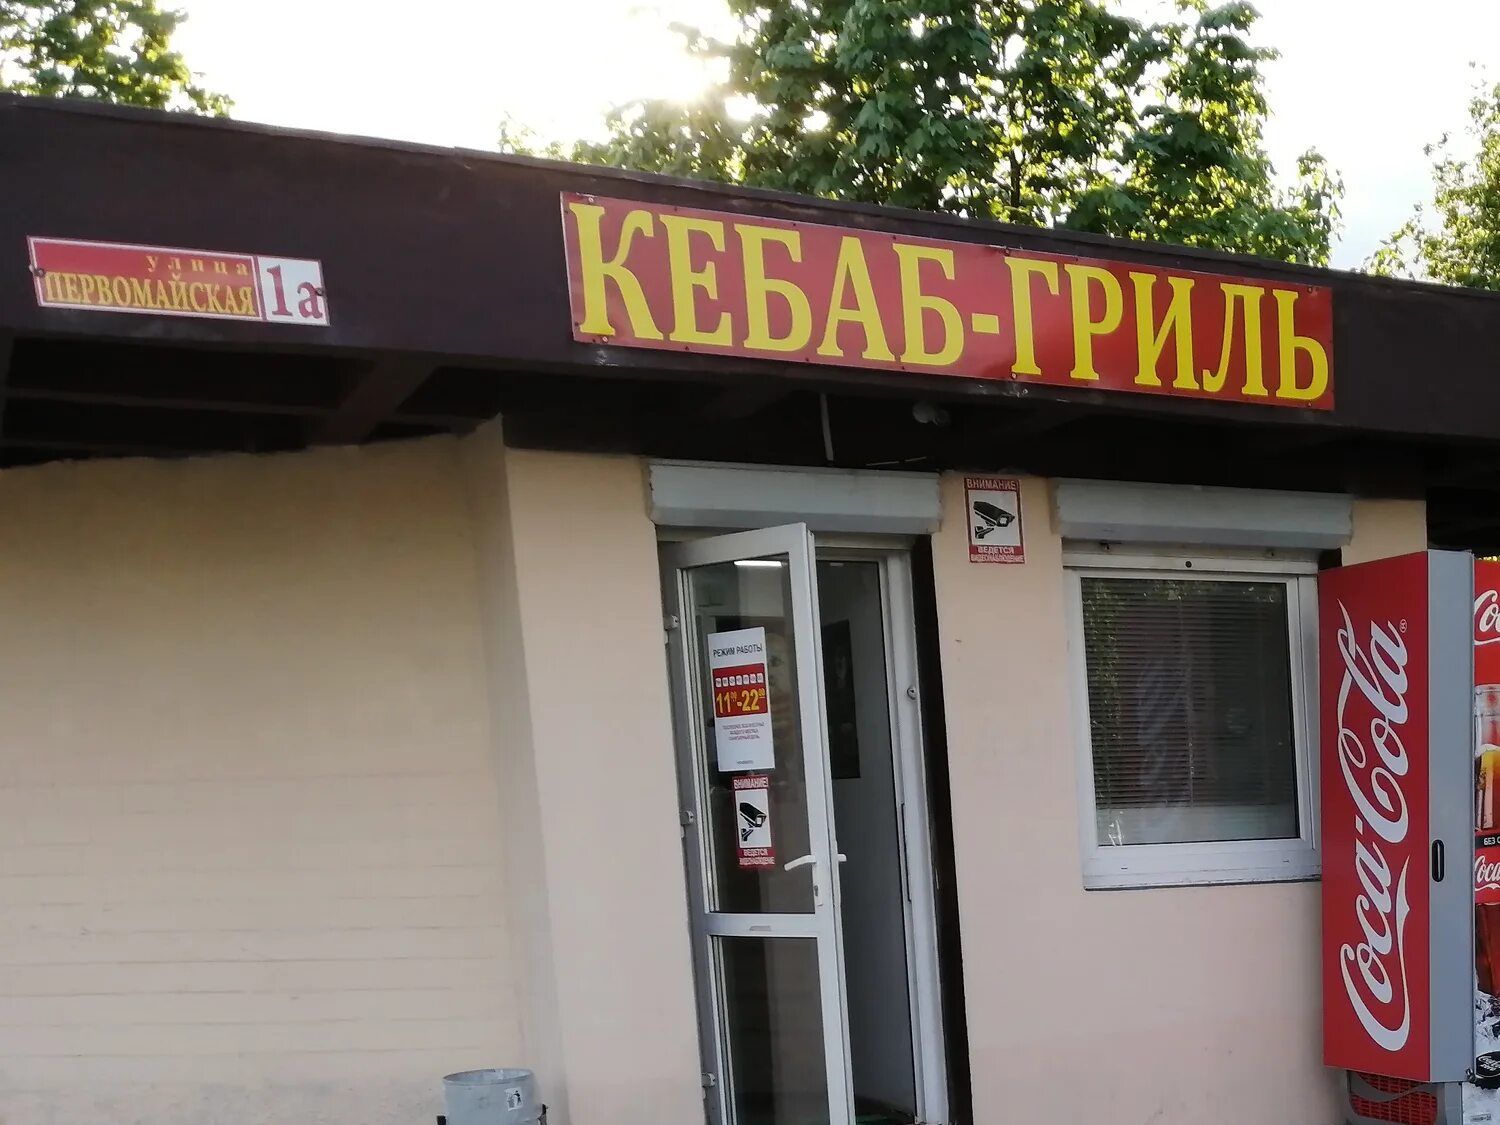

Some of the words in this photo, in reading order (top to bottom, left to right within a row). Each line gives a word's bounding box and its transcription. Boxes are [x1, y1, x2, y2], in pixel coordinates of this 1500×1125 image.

[145, 254, 249, 276] улица
[43, 271, 257, 316] ПЕРВОМАЙСКАЯ
[567, 201, 1330, 400] КЕБАБ-ГРИЛЬ
[713, 646, 735, 658] РЕЖИМ
[736, 643, 763, 654] РАБОТЫ
[1336, 598, 1411, 1052] Coca-Cola
[1483, 836, 1496, 846] БЕЗ
